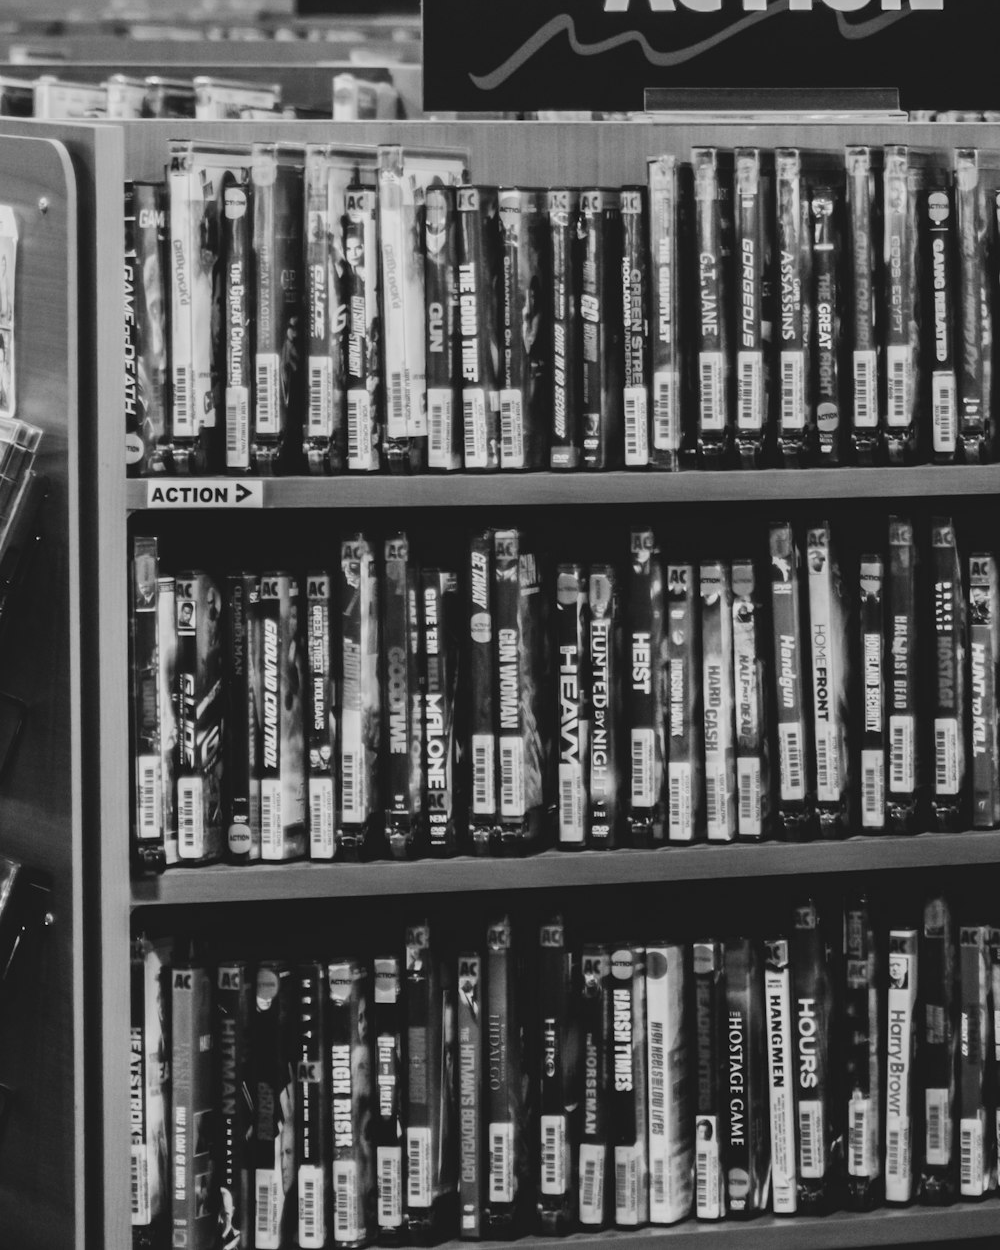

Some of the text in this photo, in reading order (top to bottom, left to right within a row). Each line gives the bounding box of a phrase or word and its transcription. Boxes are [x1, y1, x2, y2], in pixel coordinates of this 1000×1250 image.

[347, 195, 364, 210] AC
[504, 256, 512, 326] GUARANTEED
[631, 269, 642, 331] GREEN
[659, 237, 670, 343] THE GAUNTLET
[701, 291, 718, 336] JANE
[742, 238, 754, 347] GORGEOUS
[780, 251, 796, 340] ASSASSINS
[857, 278, 869, 312] FOR
[891, 236, 902, 334] GODS EGYPT
[933, 239, 947, 362] GANG RELATED
[229, 261, 245, 387] THE GREAT CHALLENG
[348, 296, 366, 379] GUTSHOT STRAIGHT
[429, 302, 443, 352] GUN
[459, 262, 479, 382] THE GOOD THIEF
[505, 329, 512, 347] ON
[554, 324, 566, 355] GONE
[622, 257, 632, 389] HOOLIGANS UNDERGRO
[818, 272, 833, 396] THE GREAT FIGHT
[124, 344, 137, 416] DEATH
[555, 356, 565, 369] IN
[555, 370, 566, 386] 60
[555, 387, 566, 438] SECONDS
[818, 412, 837, 421] ACTION
[152, 488, 228, 502] ACTION
[177, 584, 192, 598] AC
[263, 581, 279, 597] AC
[309, 581, 326, 597] AC
[471, 552, 487, 609] GETAWAY
[670, 569, 687, 585] AC
[972, 561, 988, 576] AC
[935, 582, 943, 630] WILLIS
[943, 582, 952, 631] BRUCE
[234, 645, 243, 676] MAN
[313, 605, 325, 730] GREEN STREET HOOLIGANS
[425, 588, 445, 788] GIVE 'EM HELL MALONE
[499, 628, 518, 729] GUN WOMAN
[632, 633, 651, 694] HEIST
[739, 655, 750, 686] HALF
[779, 635, 796, 708] Handgun
[814, 624, 829, 722] HOMEFRONT
[865, 633, 882, 733] HOMELAND SECURITY
[938, 636, 954, 709] HOSTAGE
[971, 643, 986, 697] HUNT
[264, 618, 278, 768] GROUND CONTROL
[388, 647, 407, 754] GOOD TIME
[559, 645, 579, 765] HEAVY
[592, 621, 607, 795] HUNTED BY NIGHT
[671, 658, 684, 737] HUDSON HAWK
[705, 665, 721, 752] HARD CASH
[740, 703, 751, 736] DEAD
[894, 680, 907, 709] DEAD
[973, 716, 986, 758] KILL
[850, 911, 864, 958] HEIST
[175, 973, 191, 990] AC
[460, 961, 477, 977] AC
[489, 1014, 500, 1091] HIDALGO
[545, 1018, 555, 1077] HERO
[614, 989, 632, 1092] HARSH TIMES
[770, 995, 784, 1088] HANGMEN
[798, 998, 817, 1088] HOURS
[888, 1010, 906, 1061] Harry
[130, 1027, 143, 1146] HEATSTROKE
[222, 1019, 236, 1116] HITMAN
[332, 1045, 352, 1147] HIGH RISK
[729, 1017, 744, 1146] HOSTAGE GAME
[176, 1106, 186, 1126] HALF
[461, 1027, 476, 1183] THE HITMAN'S BODYGUARD
[176, 1134, 186, 1153] LOAF
[176, 1155, 186, 1165] OF
[176, 1166, 186, 1189] KUNG
[176, 1190, 186, 1200] FU
